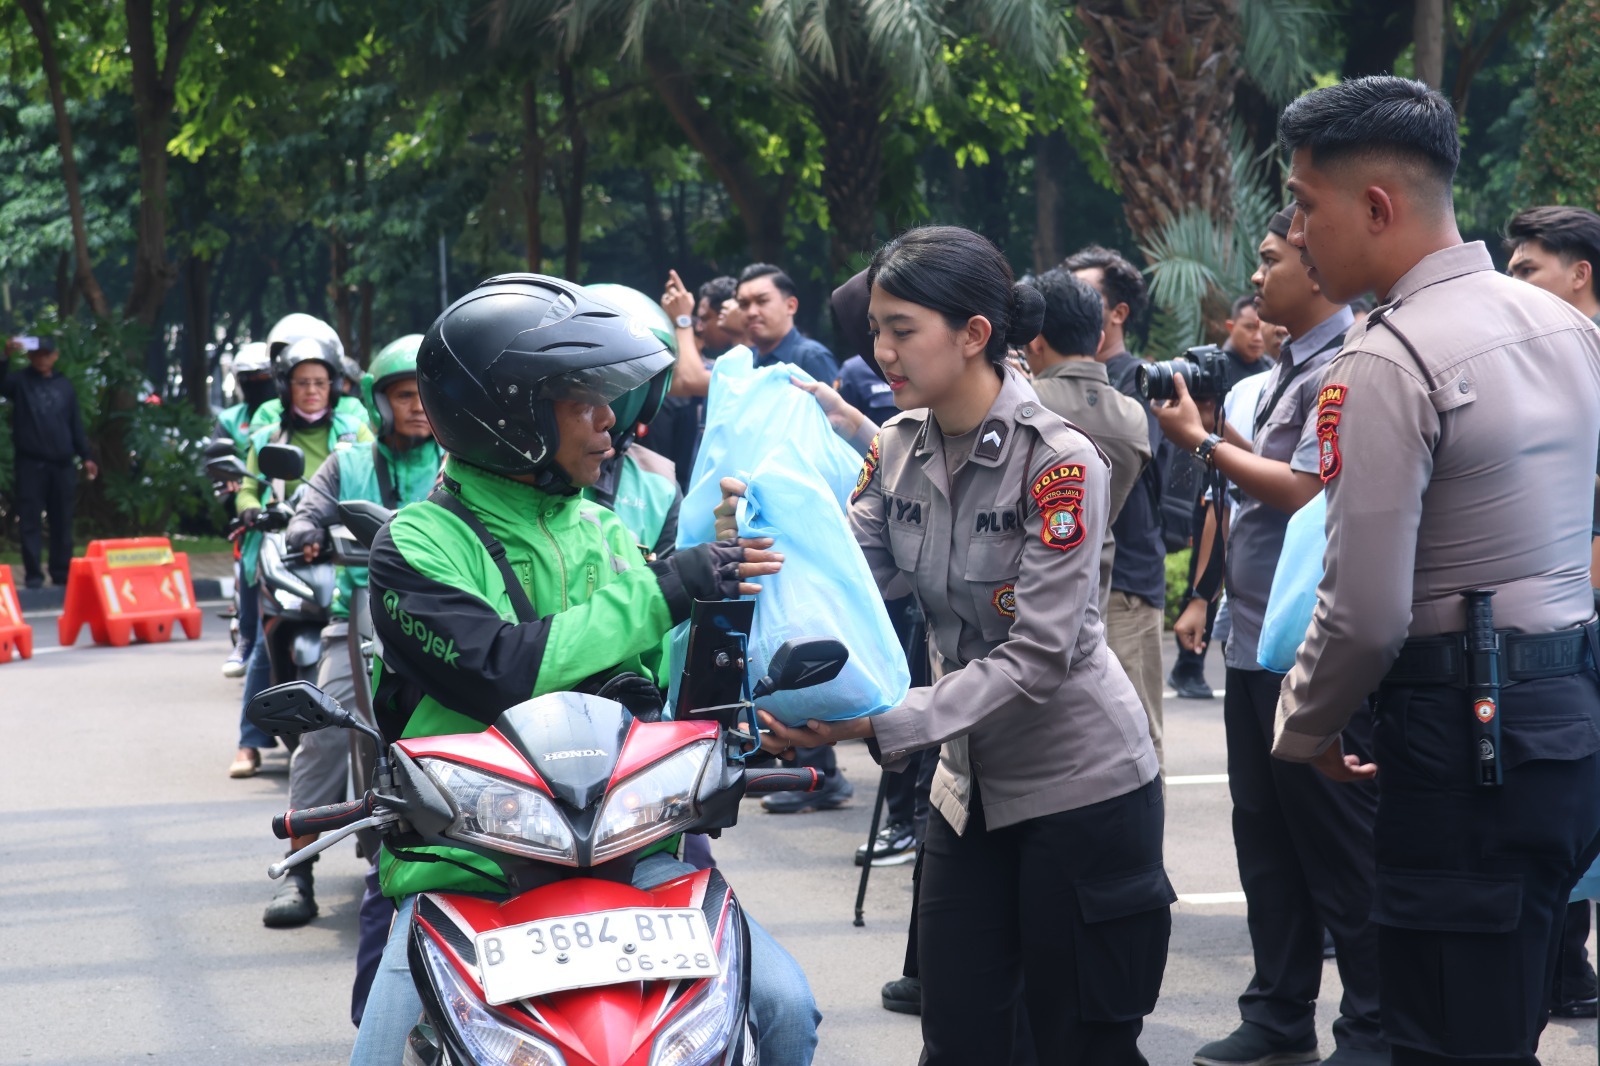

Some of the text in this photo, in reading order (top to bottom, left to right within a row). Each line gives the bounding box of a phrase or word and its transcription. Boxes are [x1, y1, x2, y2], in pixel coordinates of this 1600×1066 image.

[1034, 466, 1080, 493] POLDA
[399, 609, 460, 669] gojek
[543, 749, 608, 761] HONDA
[484, 913, 695, 966] B 3684 BTT
